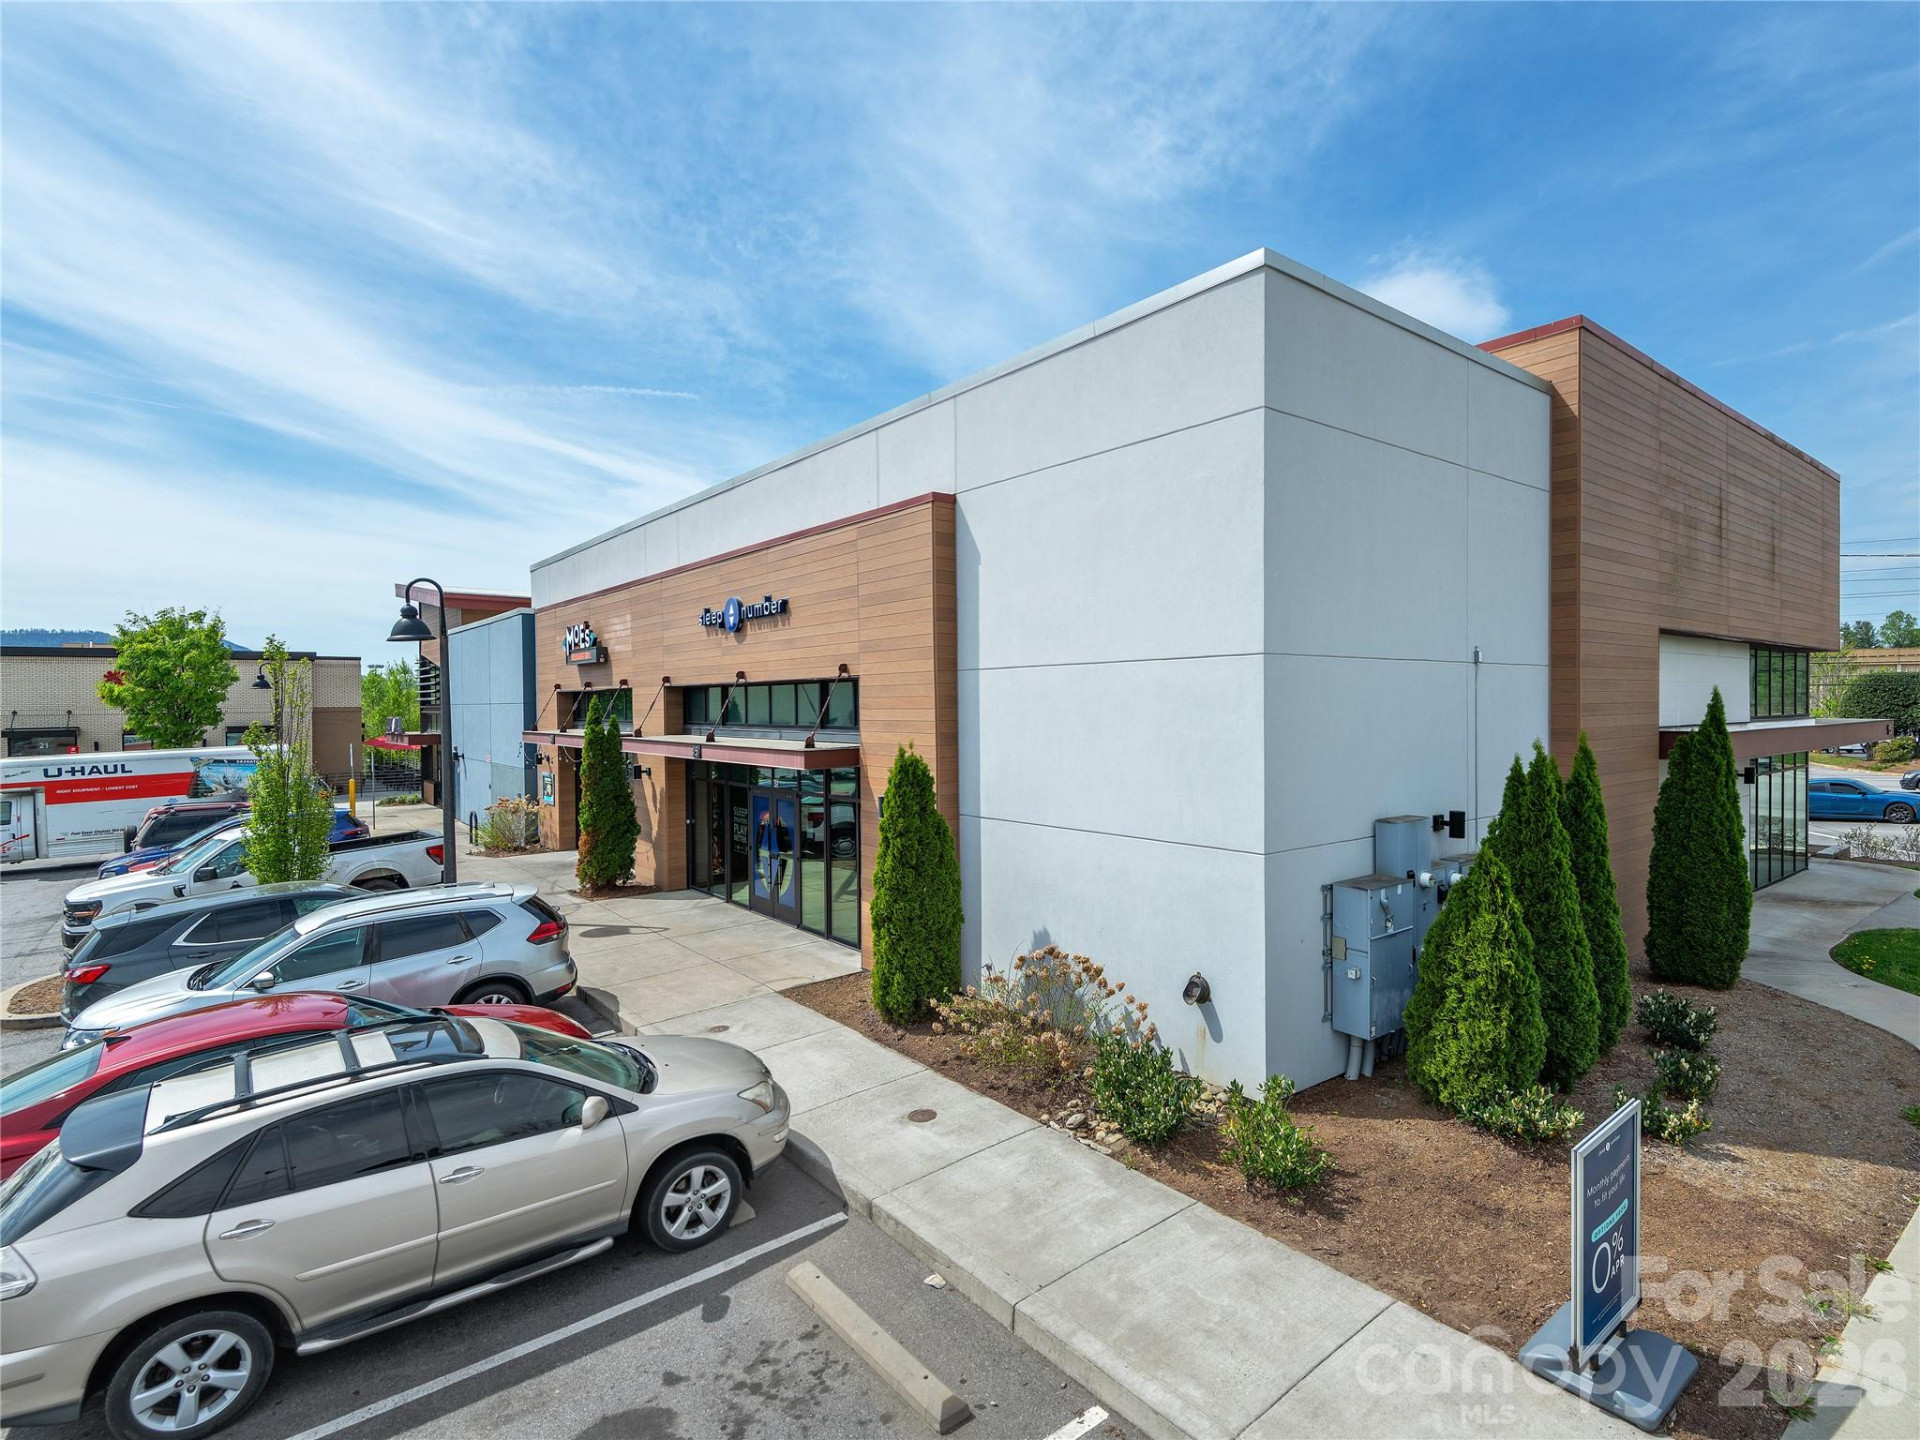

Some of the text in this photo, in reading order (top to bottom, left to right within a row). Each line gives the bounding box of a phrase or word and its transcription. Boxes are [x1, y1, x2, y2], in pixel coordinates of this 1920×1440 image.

[740, 595, 784, 620] number
[43, 763, 132, 778] U-HAUL
[733, 806, 748, 817] SLEEP
[733, 823, 748, 836] PLAY
[1586, 1174, 1610, 1198] Monthly
[1594, 1198, 1601, 1208] to
[1608, 1181, 1619, 1199] your
[1611, 1253, 1625, 1279] APR
